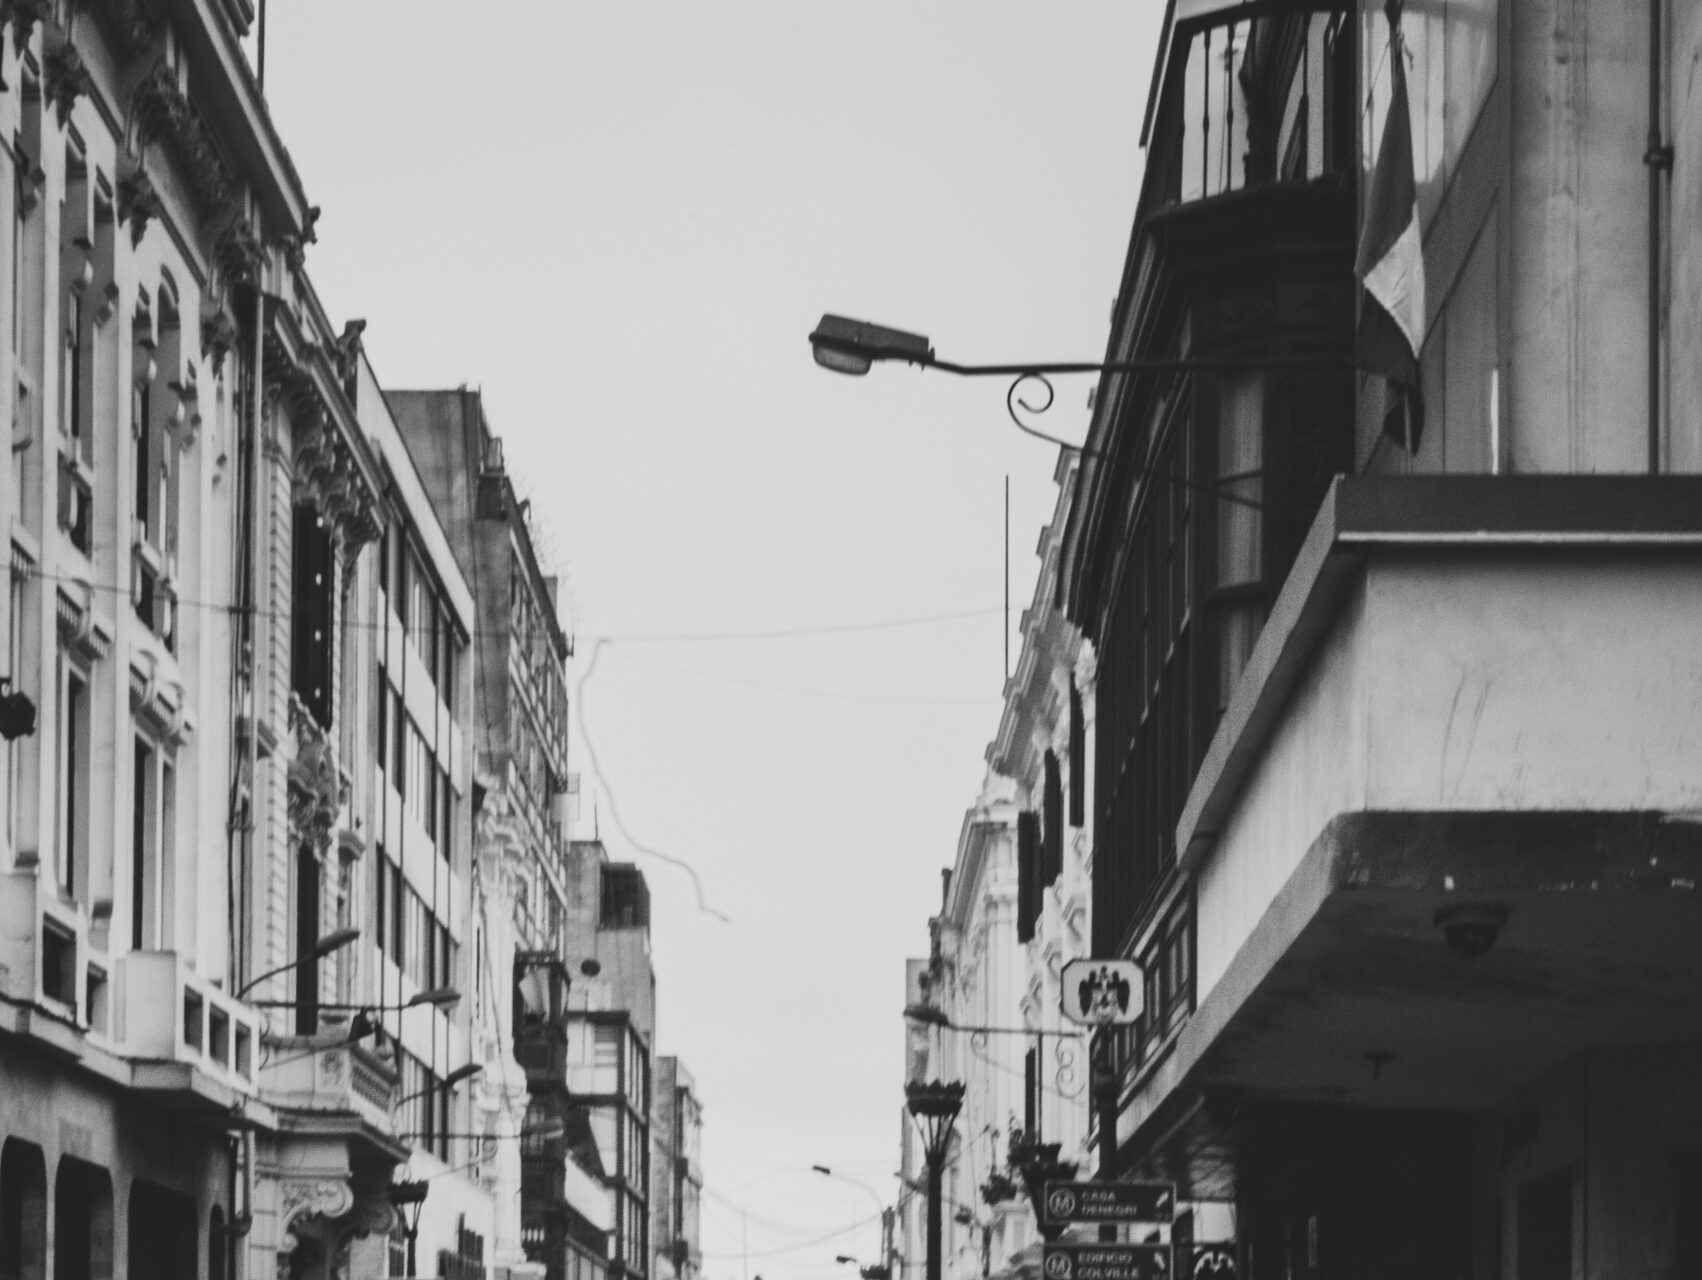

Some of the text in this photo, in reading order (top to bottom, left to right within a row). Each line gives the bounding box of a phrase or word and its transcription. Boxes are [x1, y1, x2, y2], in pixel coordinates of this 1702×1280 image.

[1081, 1190, 1116, 1202] CASA
[1078, 1252, 1133, 1264] EDIFICIO
[1077, 1268, 1139, 1280] COLVILLE
